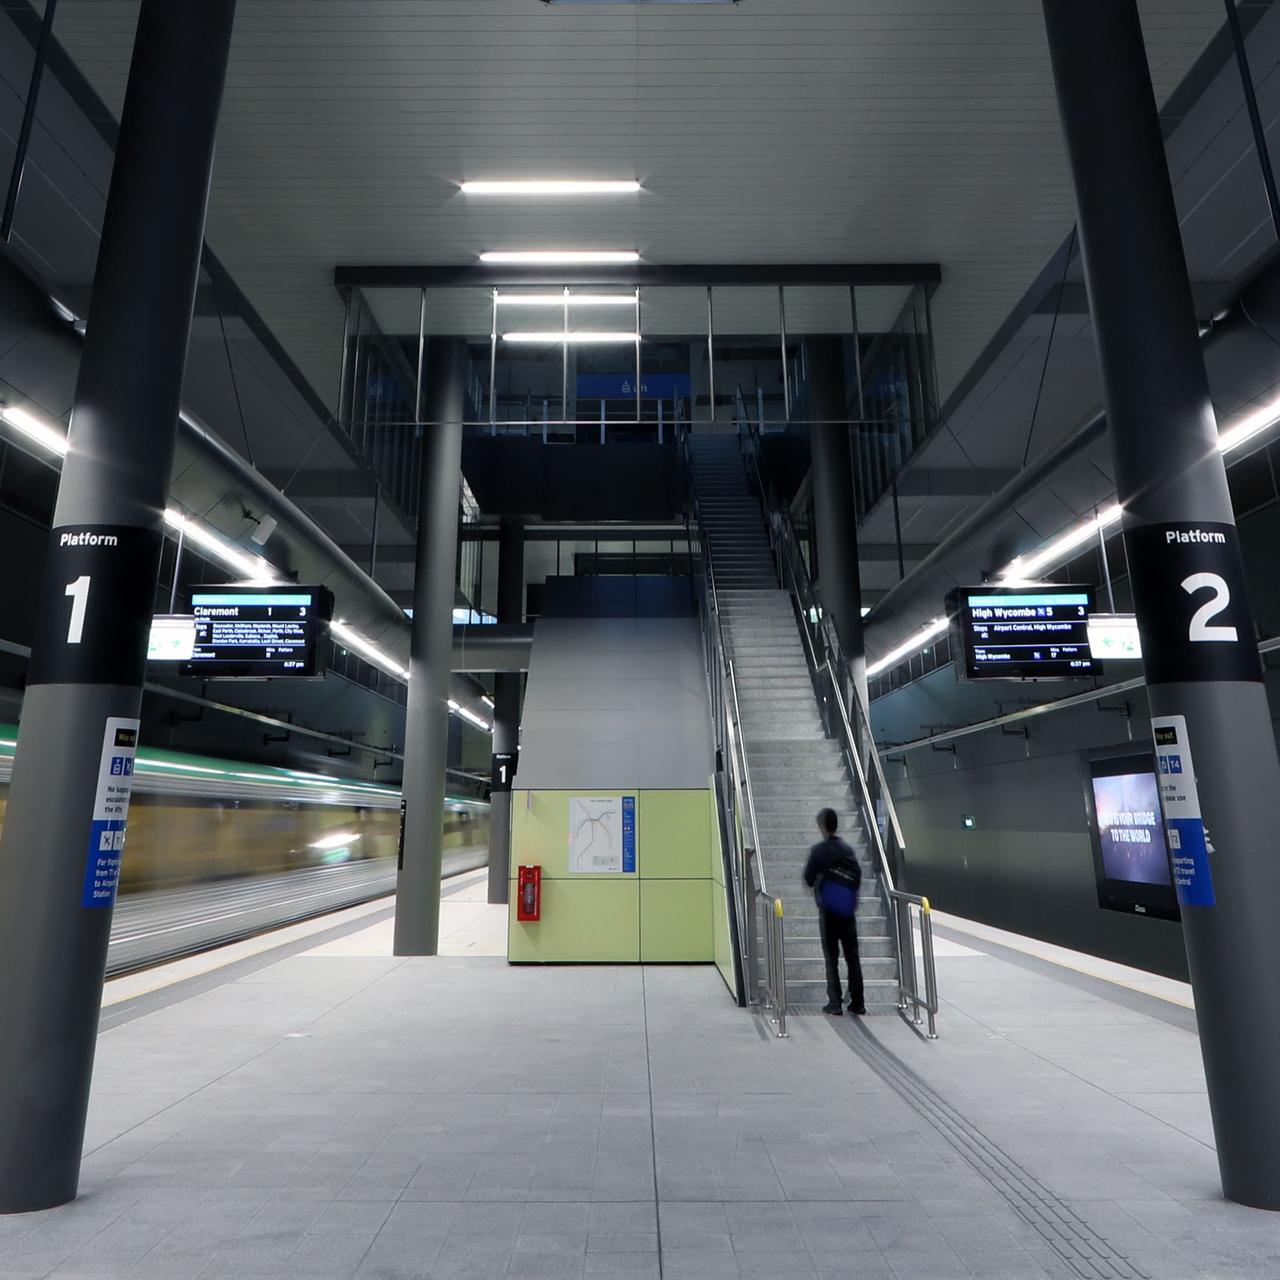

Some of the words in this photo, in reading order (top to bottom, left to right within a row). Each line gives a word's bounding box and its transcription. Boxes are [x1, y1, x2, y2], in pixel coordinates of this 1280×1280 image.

[633, 384, 648, 393] Lft
[60, 532, 118, 547] Platform
[1165, 529, 1226, 544] Platform
[64, 575, 91, 644] 1
[193, 606, 239, 616] Claremont
[267, 606, 272, 616] 1
[299, 606, 306, 616] 3
[972, 607, 993, 619] High
[994, 607, 1036, 619] Wycombe
[1045, 606, 1053, 616] 5
[1077, 606, 1085, 616] 3
[1180, 572, 1239, 642] 2
[499, 765, 506, 783] 1
[1110, 828, 1119, 842] TO
[1130, 828, 1151, 843] WORLD
